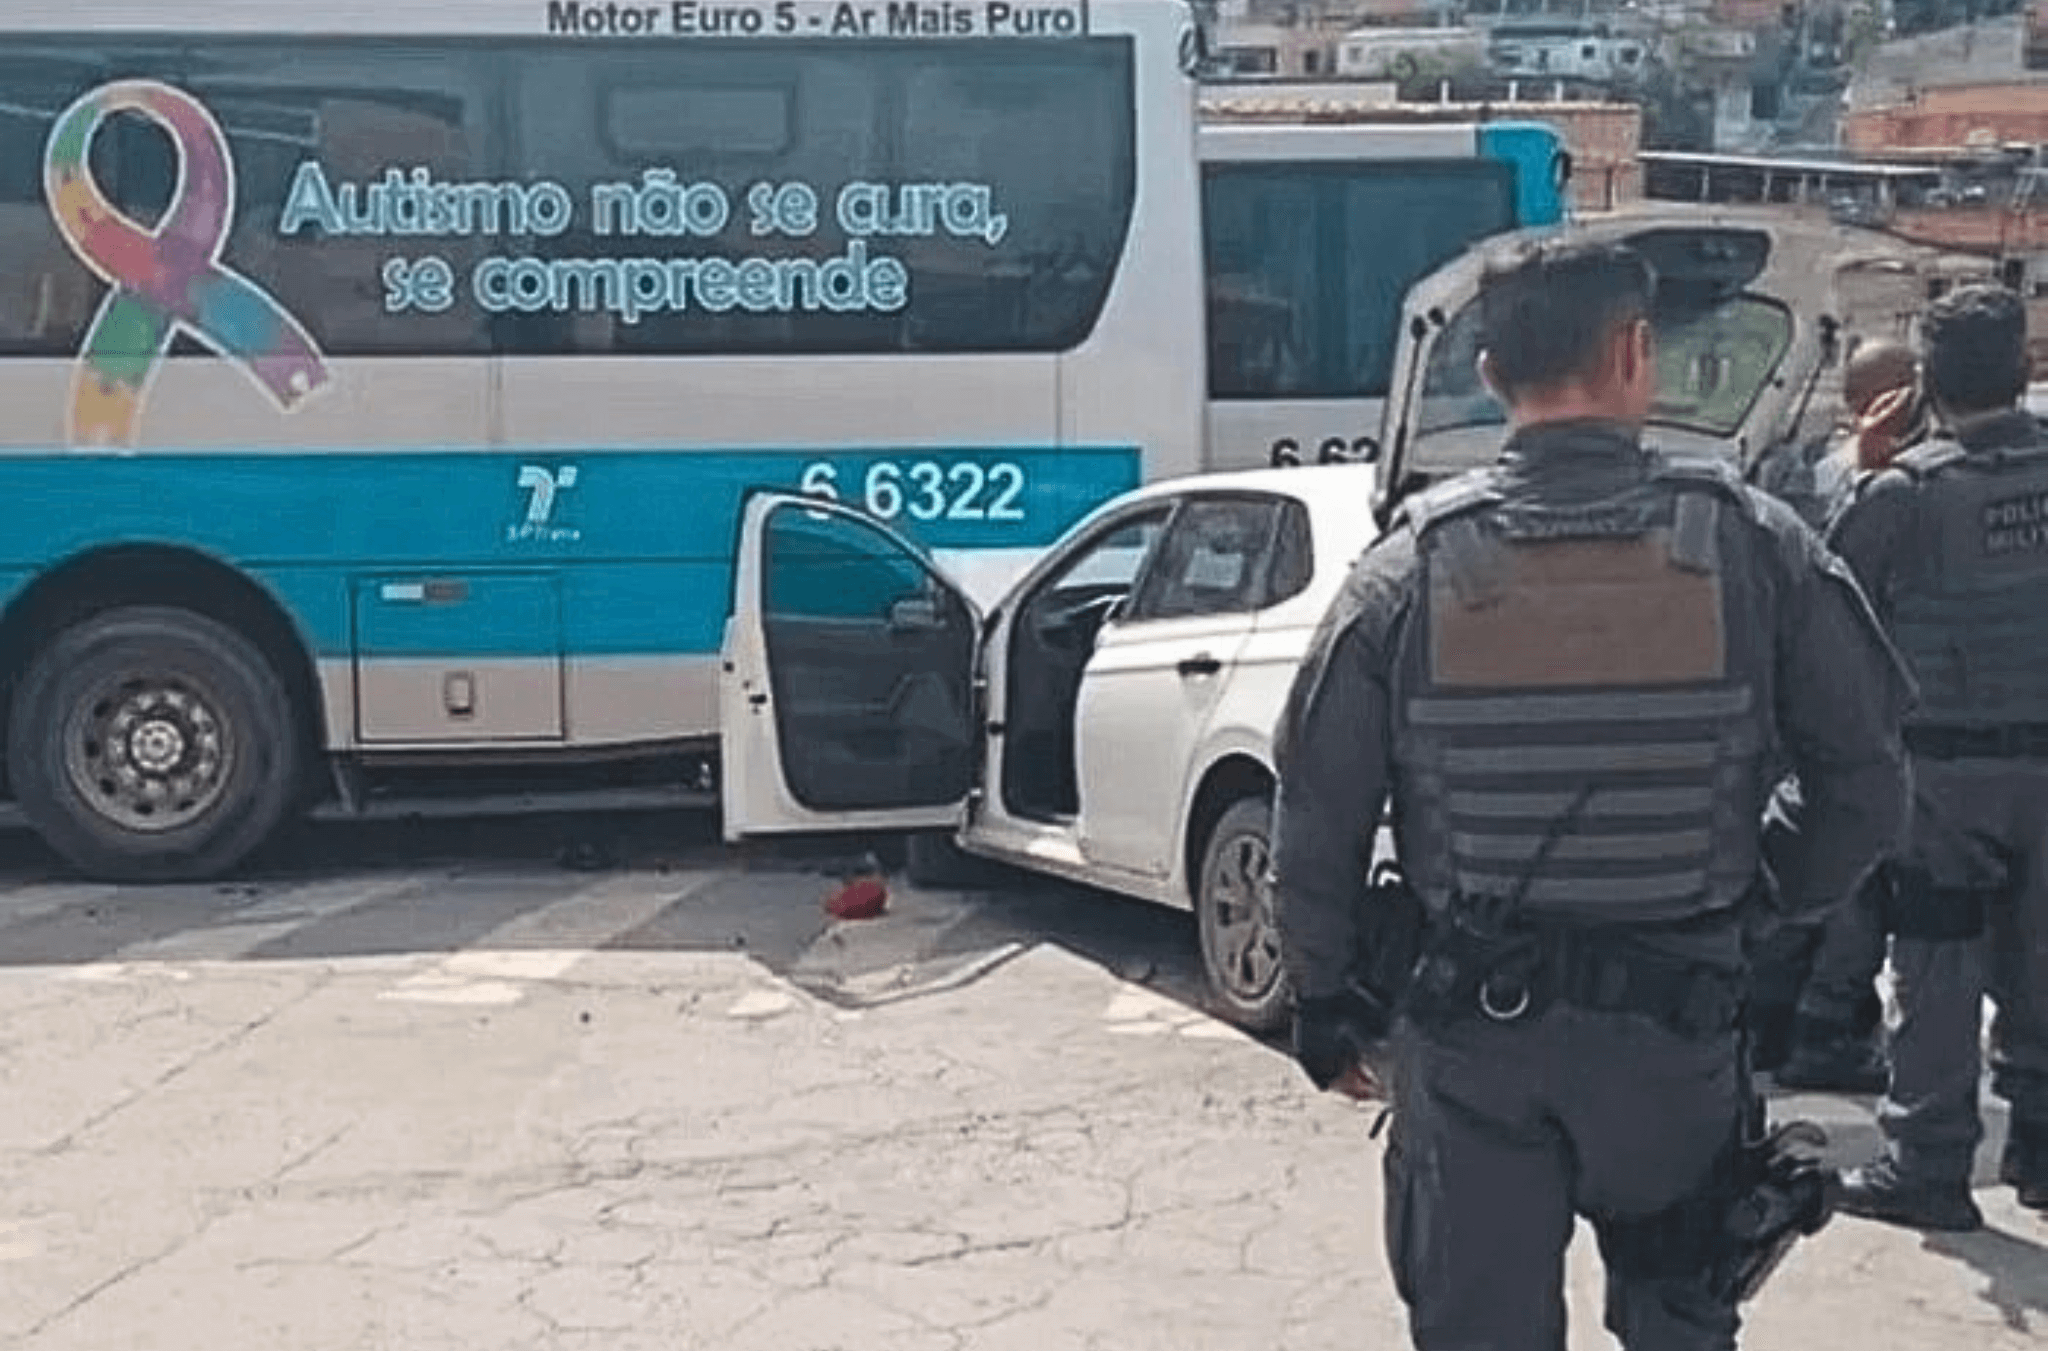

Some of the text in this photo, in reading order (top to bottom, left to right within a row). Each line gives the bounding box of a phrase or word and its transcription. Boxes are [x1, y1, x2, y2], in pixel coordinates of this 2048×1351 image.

[548, 1, 660, 34] Motor
[672, 1, 762, 34] Euro
[775, 1, 797, 34] 5
[832, 1, 876, 34] Ar
[888, 1, 972, 34] Mais
[987, 1, 1075, 34] Puro
[280, 161, 1008, 244] Autismo não se cura,
[382, 238, 908, 323] se compreende
[801, 462, 1025, 520] 6 6322
